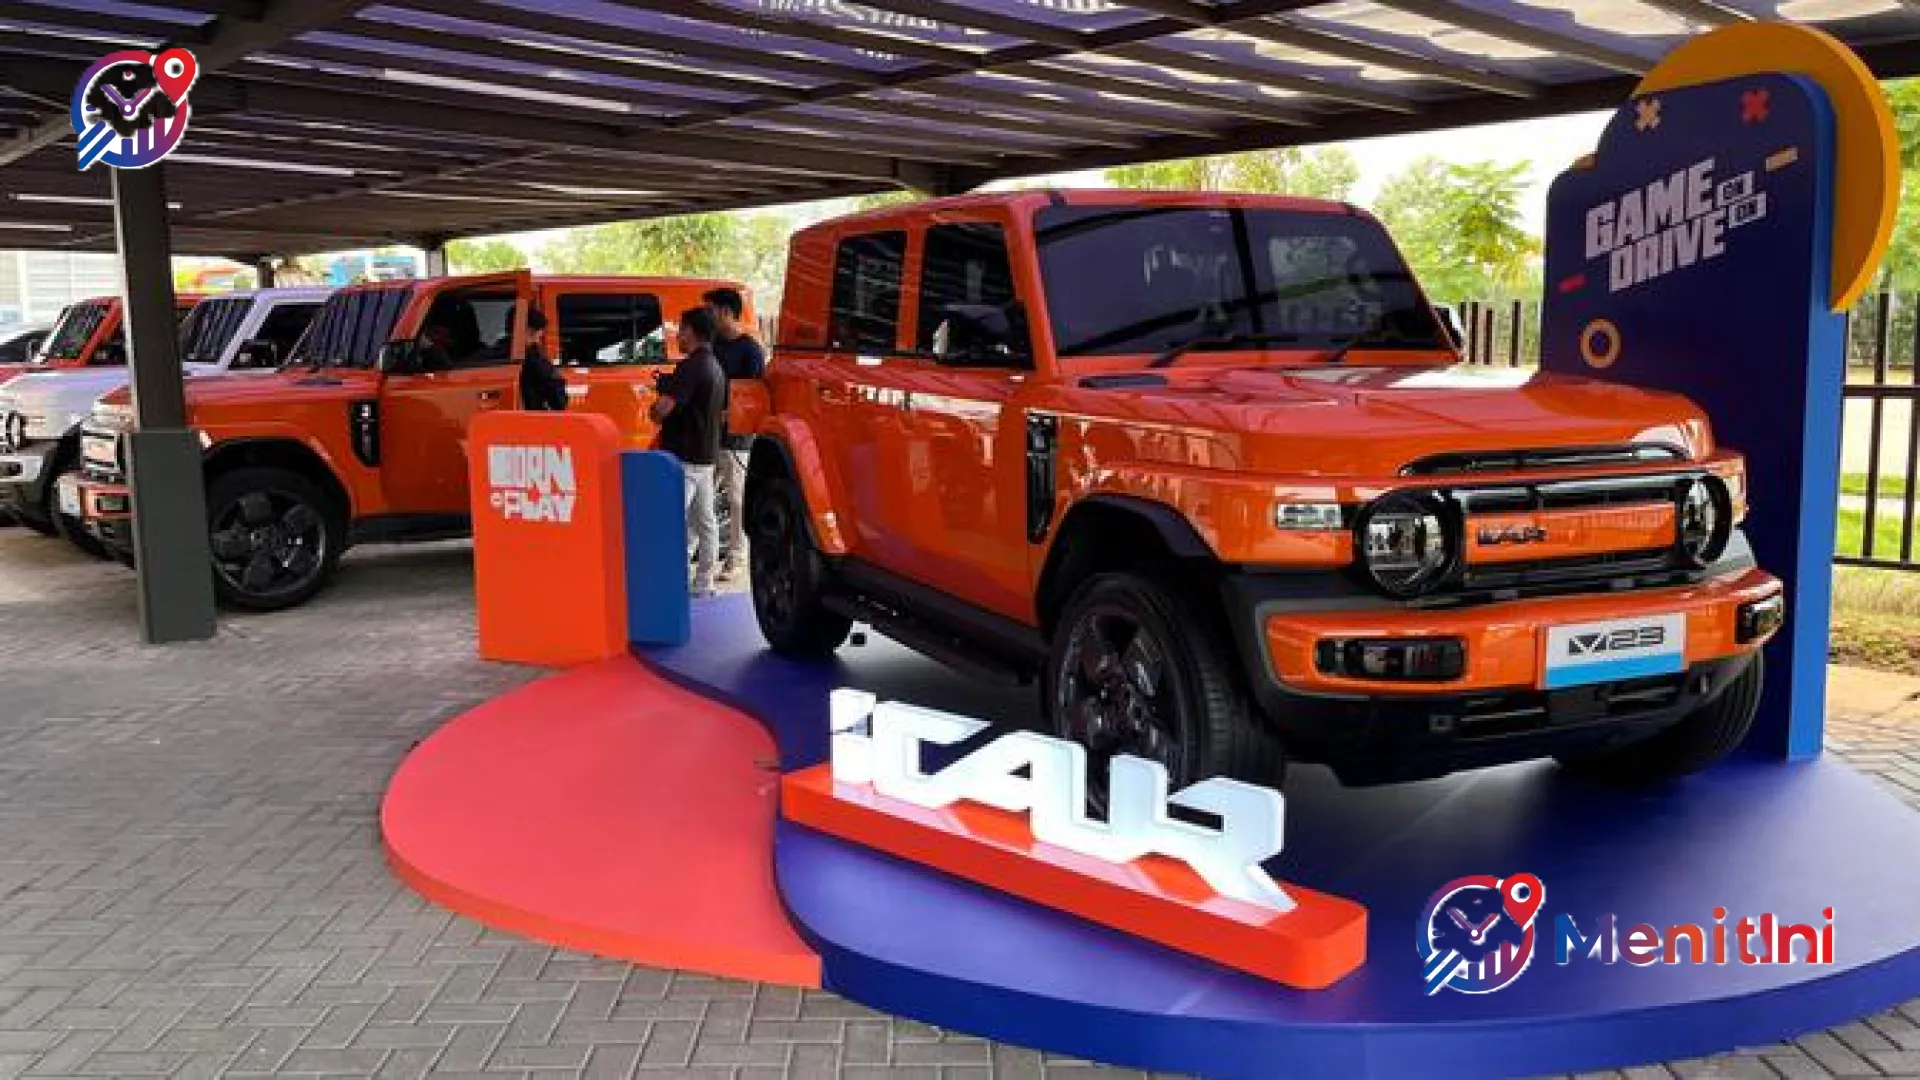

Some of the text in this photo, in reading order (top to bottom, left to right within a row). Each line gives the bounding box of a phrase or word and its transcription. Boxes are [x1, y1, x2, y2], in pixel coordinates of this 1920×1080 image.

[1585, 157, 1715, 260] GAME
[1610, 209, 1726, 292] DRIVE
[504, 490, 575, 521] PLAY
